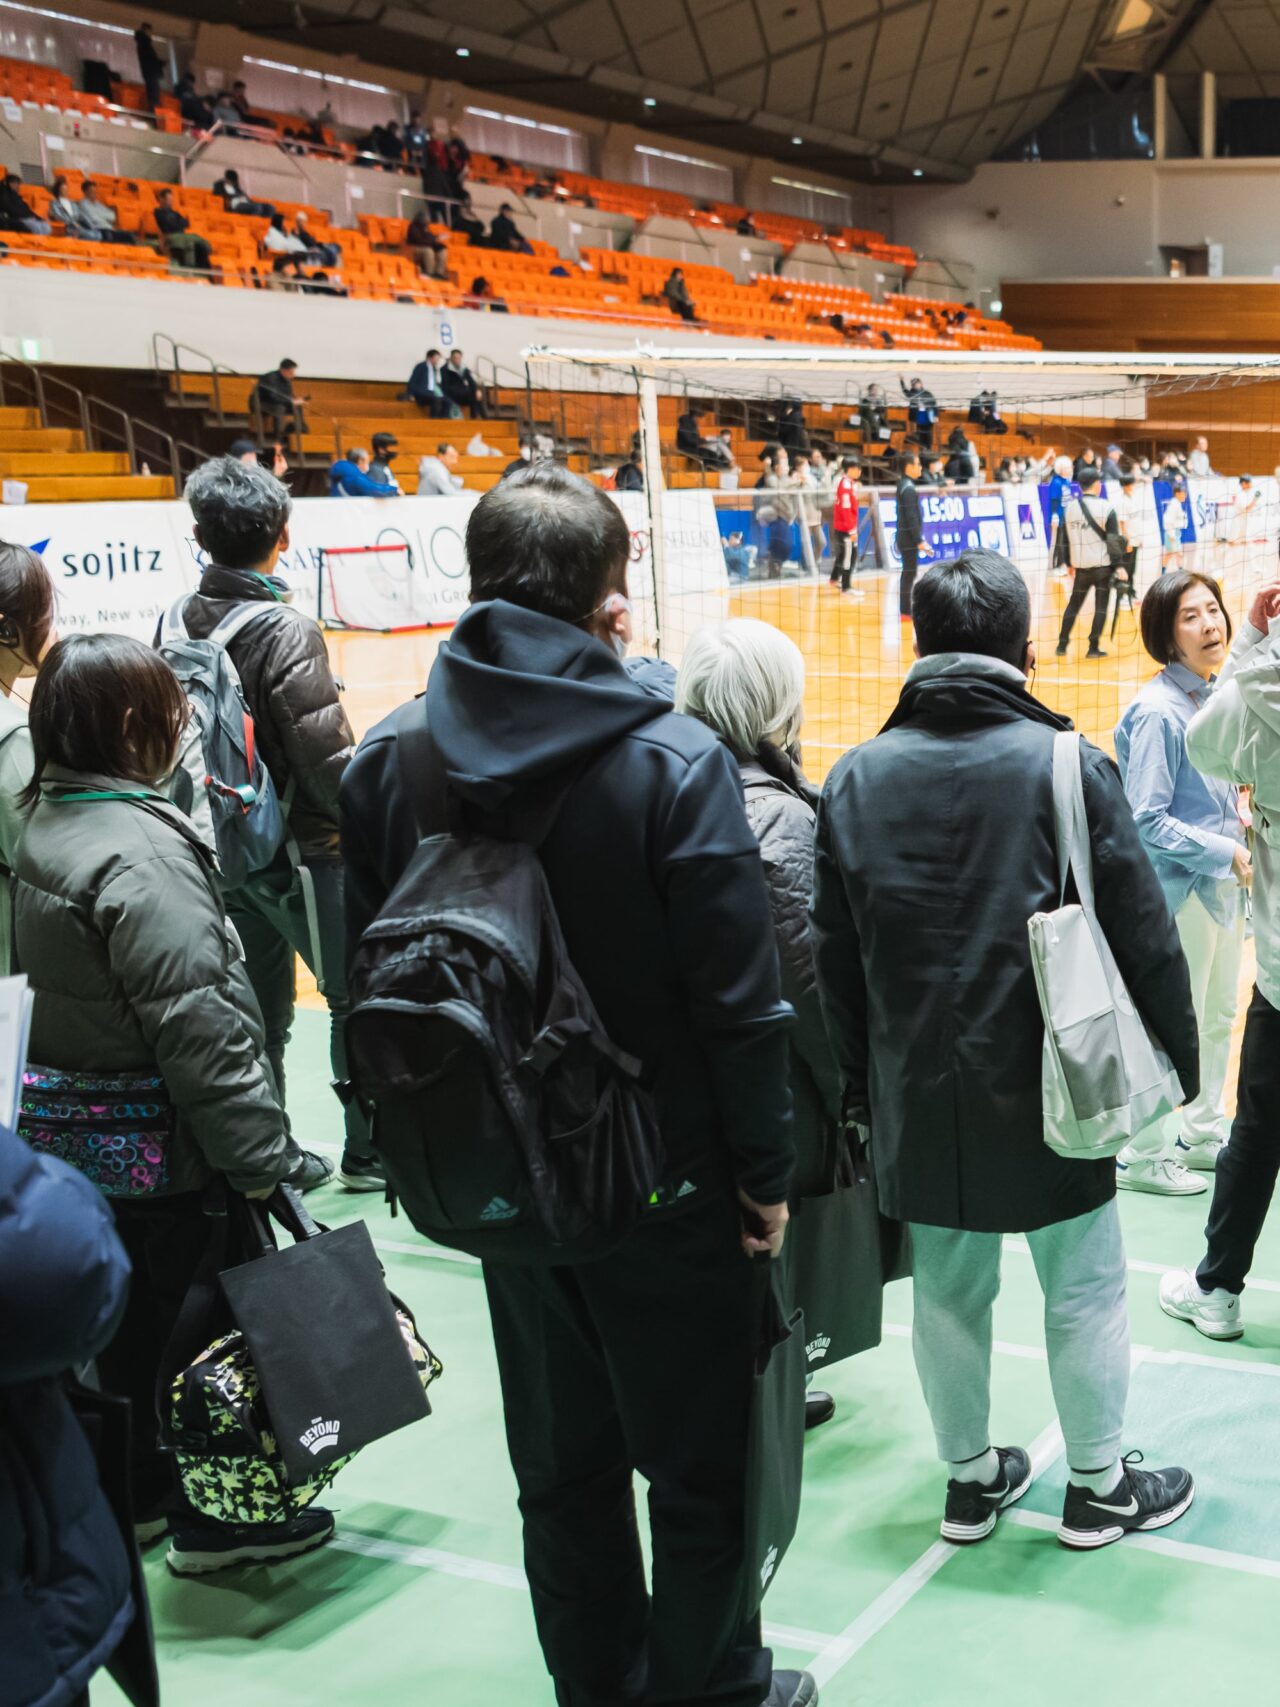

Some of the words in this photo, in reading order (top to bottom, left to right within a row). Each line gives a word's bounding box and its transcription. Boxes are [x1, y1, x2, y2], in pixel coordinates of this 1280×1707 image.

[921, 496, 965, 522] 15:00
[62, 542, 163, 581] sojitz
[98, 608, 131, 623] New
[299, 1420, 341, 1448] BEYOND
